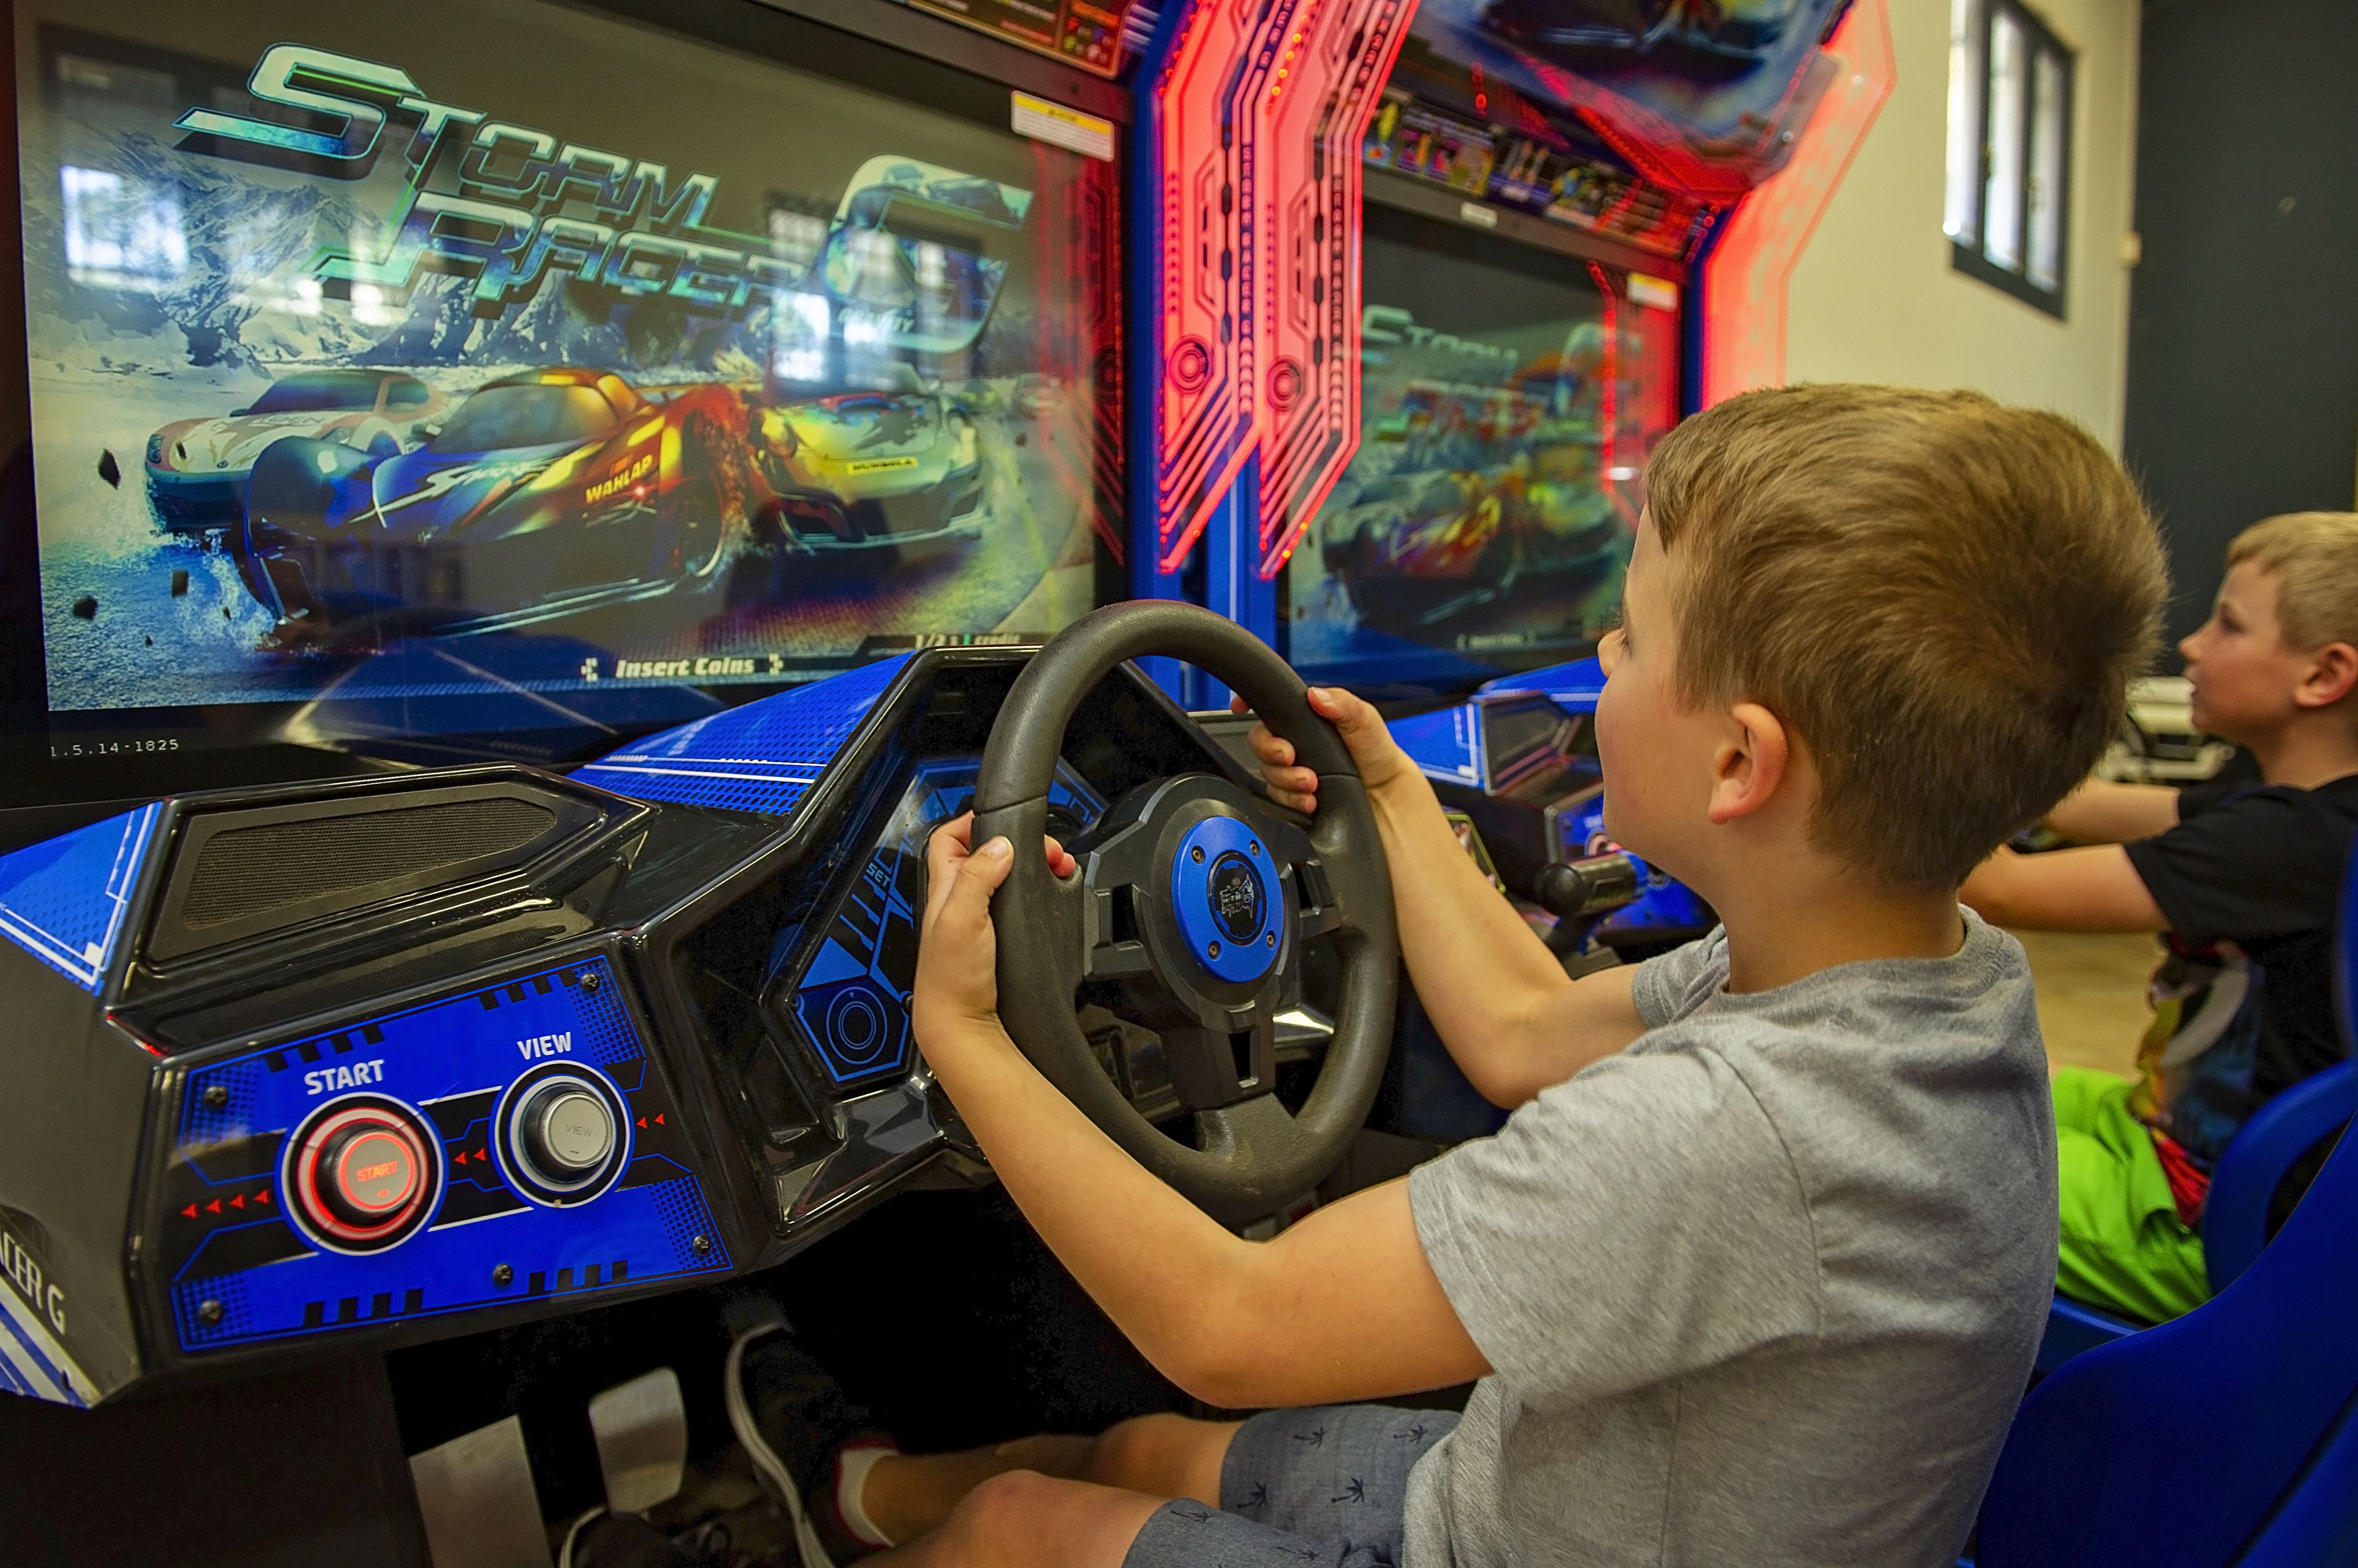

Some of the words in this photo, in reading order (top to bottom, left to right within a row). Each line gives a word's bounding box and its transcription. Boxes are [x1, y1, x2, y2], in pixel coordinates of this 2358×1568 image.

[171, 41, 721, 229] STORM
[585, 454, 653, 503] WAHLAP
[615, 658, 691, 679] Insert
[694, 656, 755, 676] Coins
[866, 862, 892, 887] SET
[517, 1031, 572, 1060] VIEW
[303, 1059, 384, 1095] START
[566, 1123, 594, 1137] VIEW
[356, 1160, 399, 1182] START
[0, 1230, 42, 1310] CER
[47, 1284, 64, 1335] G
